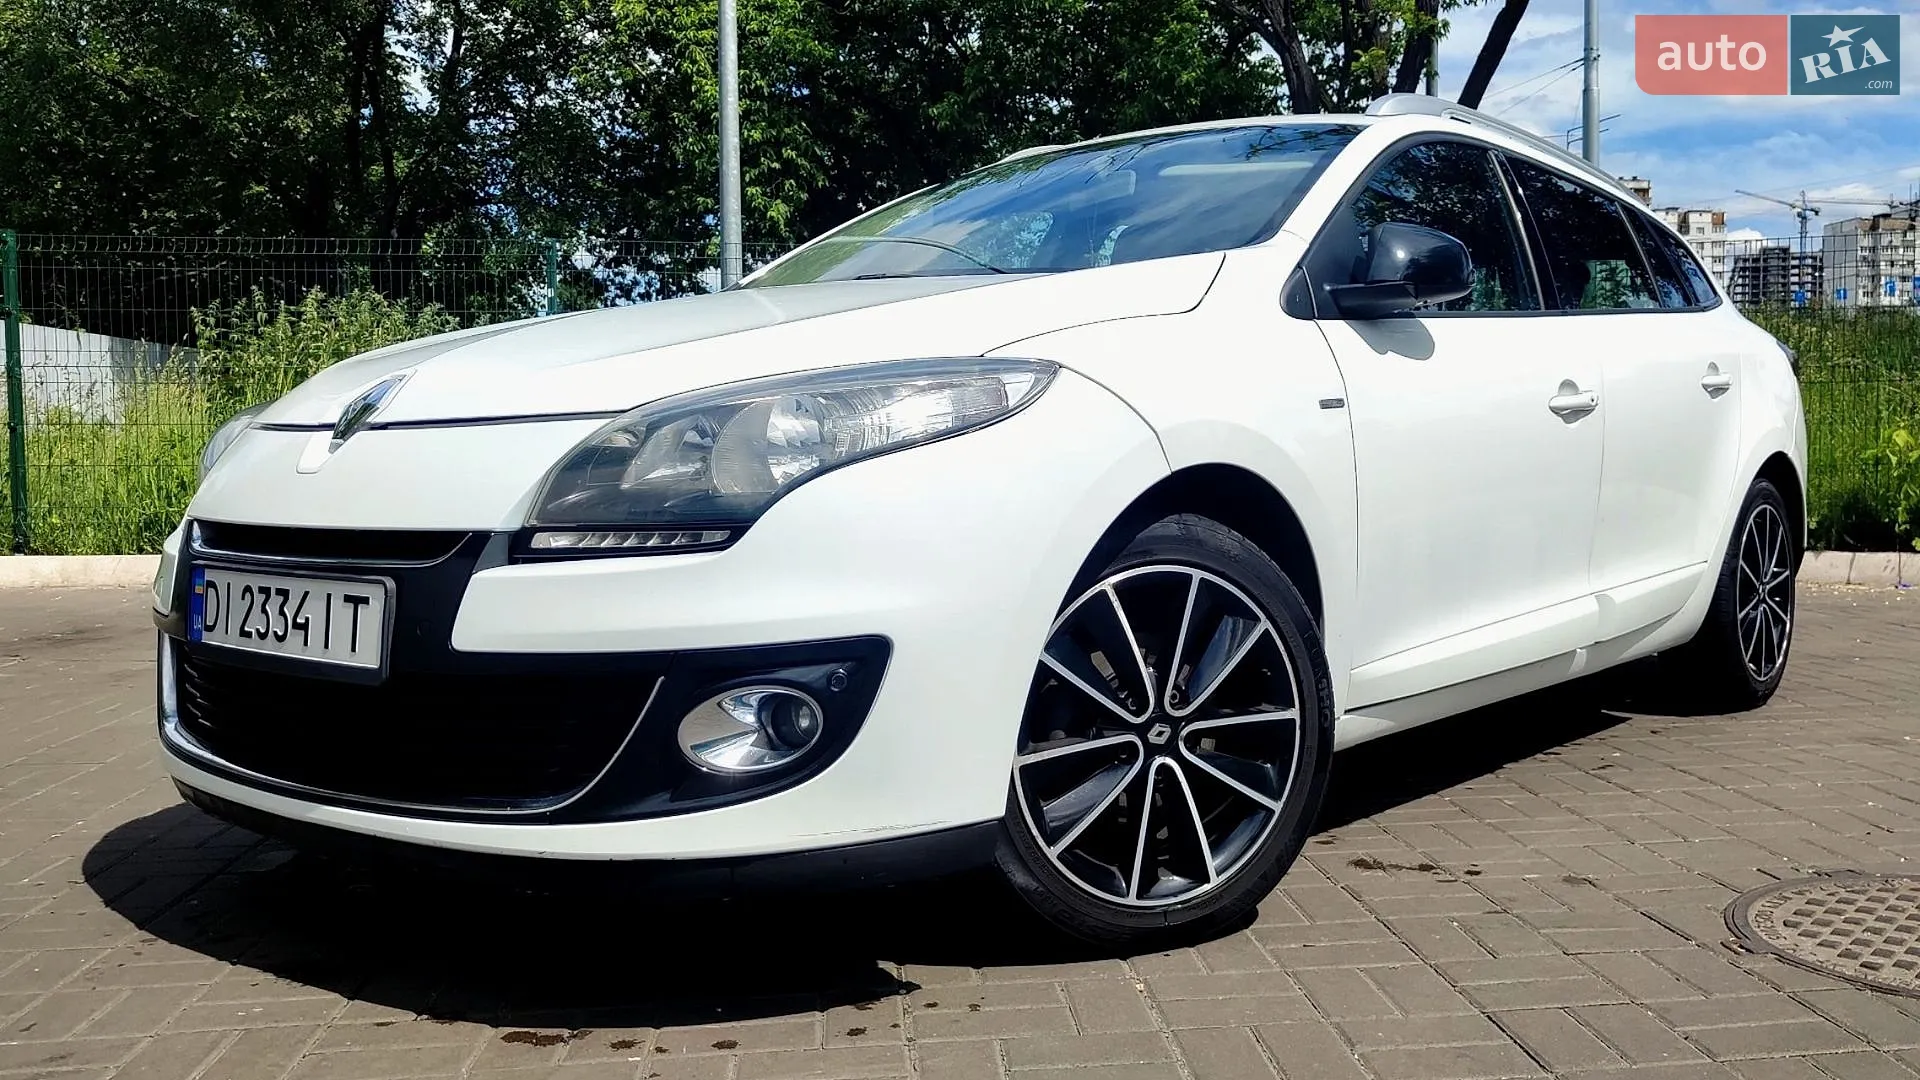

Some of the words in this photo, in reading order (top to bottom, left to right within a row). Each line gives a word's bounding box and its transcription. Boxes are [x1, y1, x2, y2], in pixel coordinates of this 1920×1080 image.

[193, 613, 202, 630] UA
[204, 579, 231, 635] DI
[239, 584, 311, 647] 2334
[323, 592, 370, 653] IT
